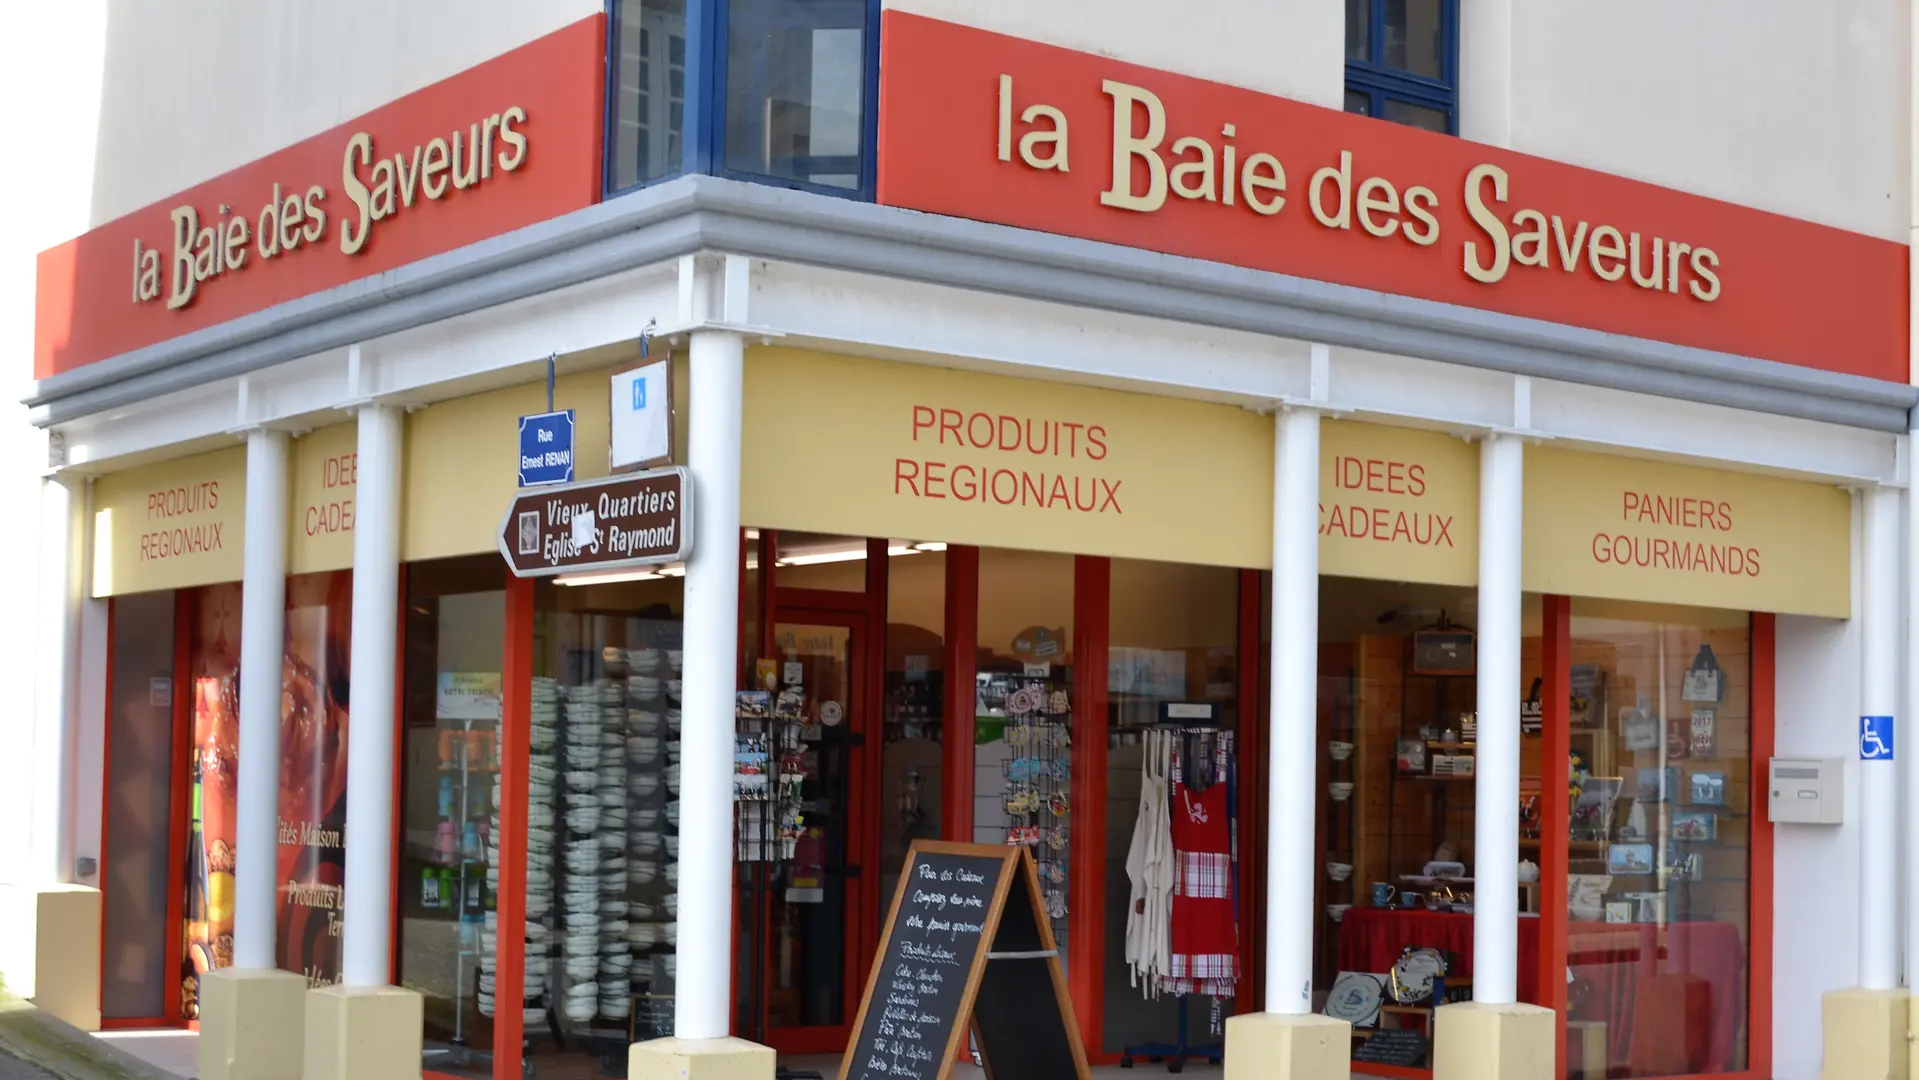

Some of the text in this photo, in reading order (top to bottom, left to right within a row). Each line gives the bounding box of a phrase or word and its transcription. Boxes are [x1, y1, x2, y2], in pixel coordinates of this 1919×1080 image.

[132, 105, 528, 310] la Baie des Saveurs
[997, 74, 1722, 302] la Baie des Saveurs
[537, 427, 554, 443] Rue
[912, 404, 1108, 461] PRODUITS
[522, 449, 571, 470] Ernest RENAN
[1334, 455, 1427, 497] IDEES
[147, 481, 219, 521] PRODUITS
[598, 486, 675, 519] Quartiers
[894, 457, 1123, 515] REGIONAUX
[1623, 490, 1734, 533] PANIERS
[140, 522, 223, 562] REGIONAUX
[608, 517, 675, 556] Raymond
[1591, 533, 1762, 578] GOURMANDS
[299, 821, 340, 848] Maison
[287, 880, 335, 909] Produits
